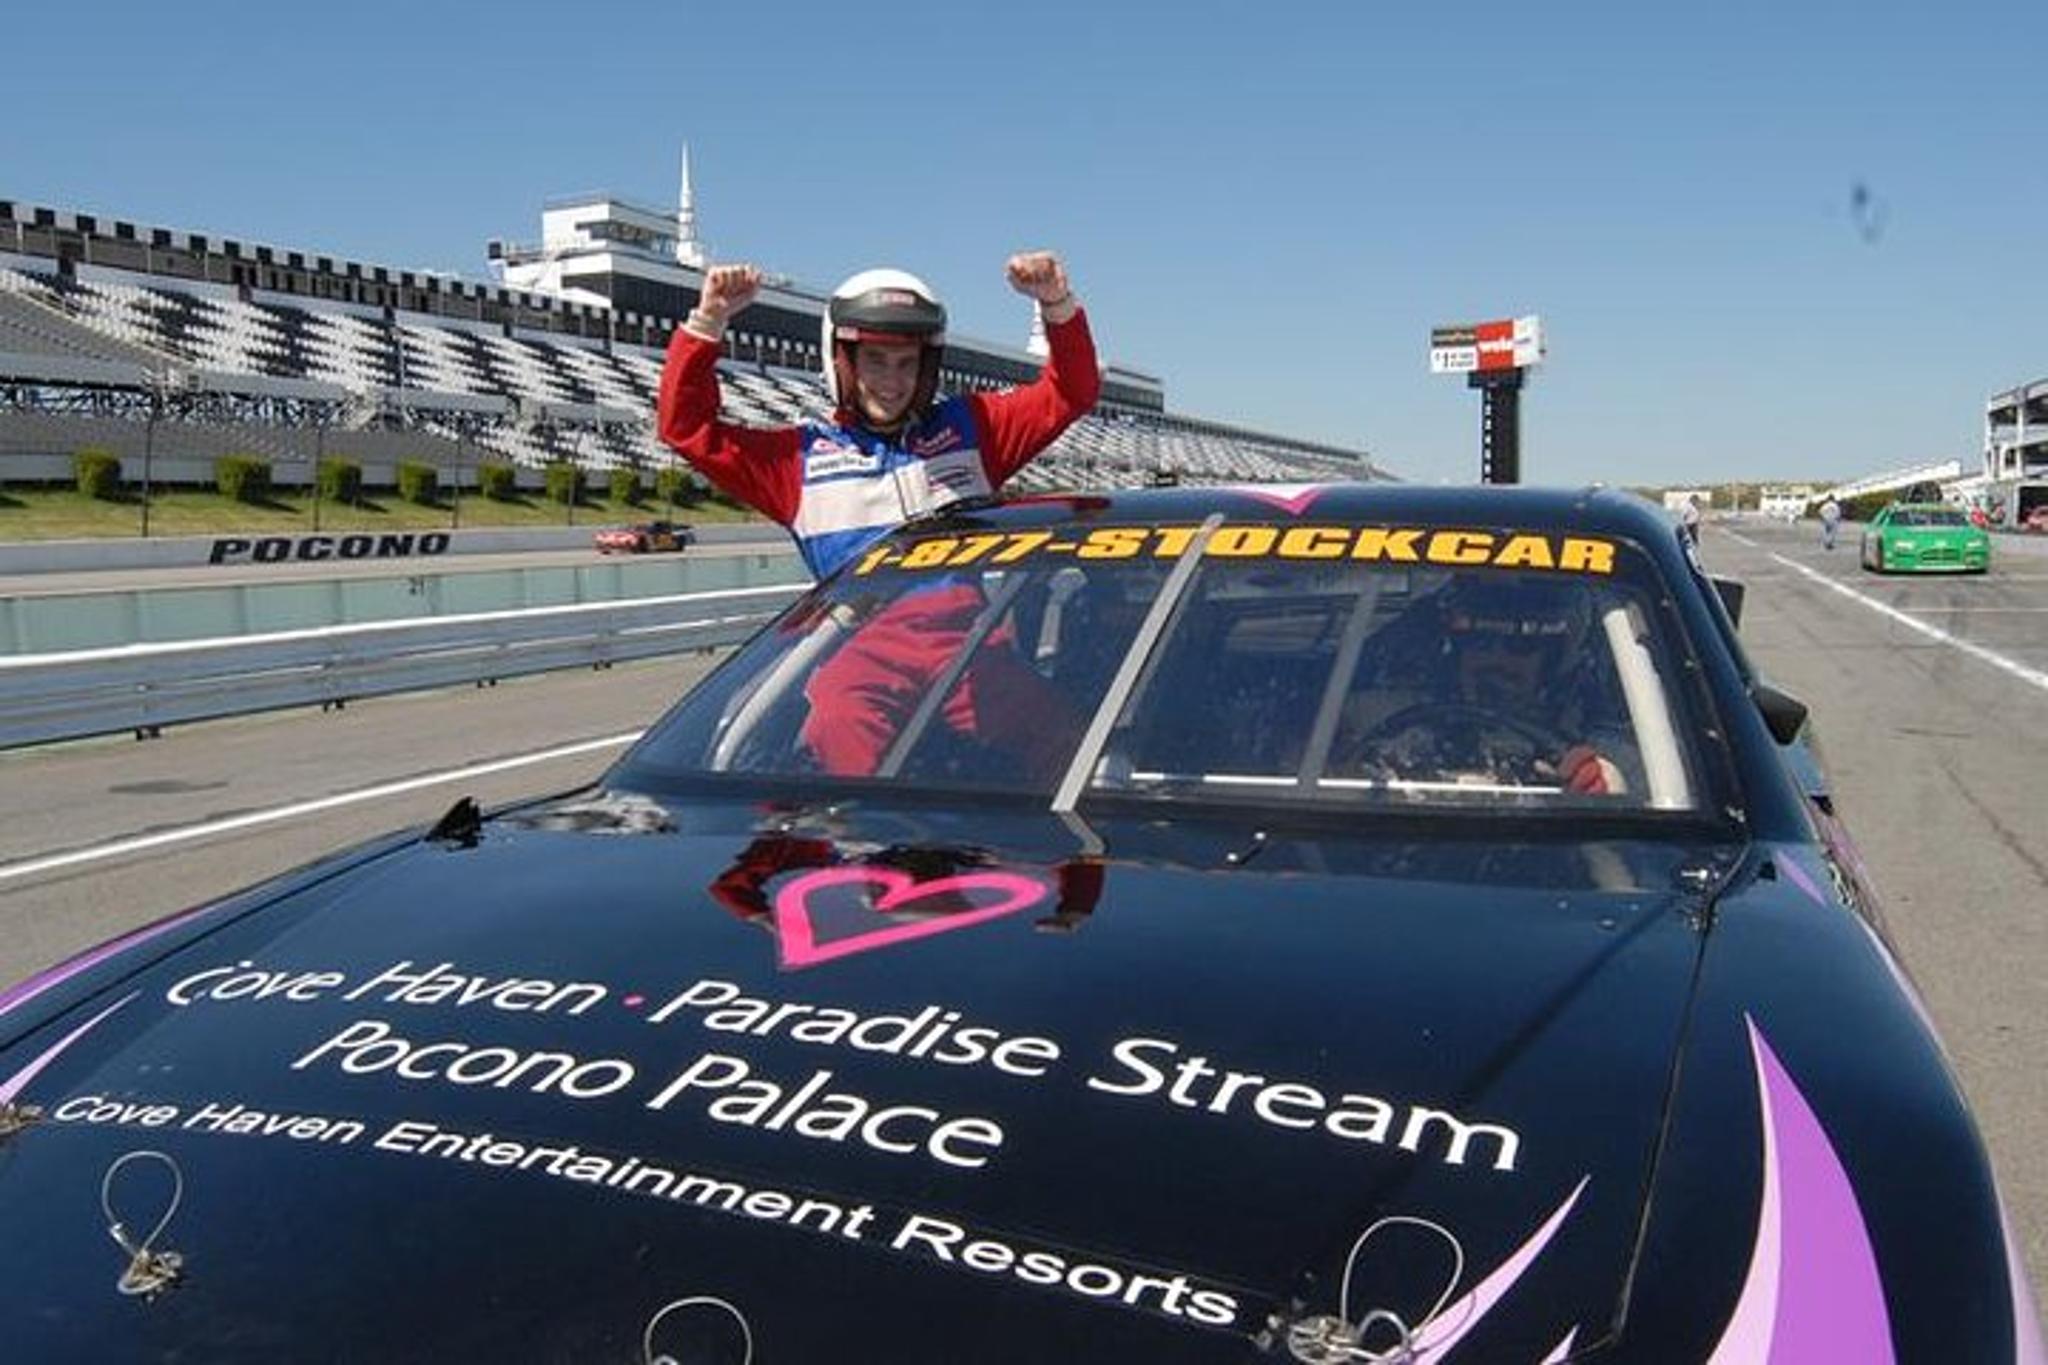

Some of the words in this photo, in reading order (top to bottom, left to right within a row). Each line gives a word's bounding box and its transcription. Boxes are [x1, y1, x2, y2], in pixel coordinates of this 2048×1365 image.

[209, 533, 451, 565] POCONO
[853, 525, 1616, 576] 1-877-STOCKCAR
[166, 961, 345, 1005] Cove
[341, 960, 607, 1014] Haven
[646, 979, 1061, 1076] Paradise
[1086, 1038, 1520, 1171] Stream
[290, 1020, 635, 1098] Pocono
[646, 1053, 1003, 1168] Palace
[54, 1095, 179, 1127] Cove
[182, 1103, 365, 1144] Haven
[374, 1121, 875, 1239] Entertainment
[892, 1215, 1237, 1325] Resorts
